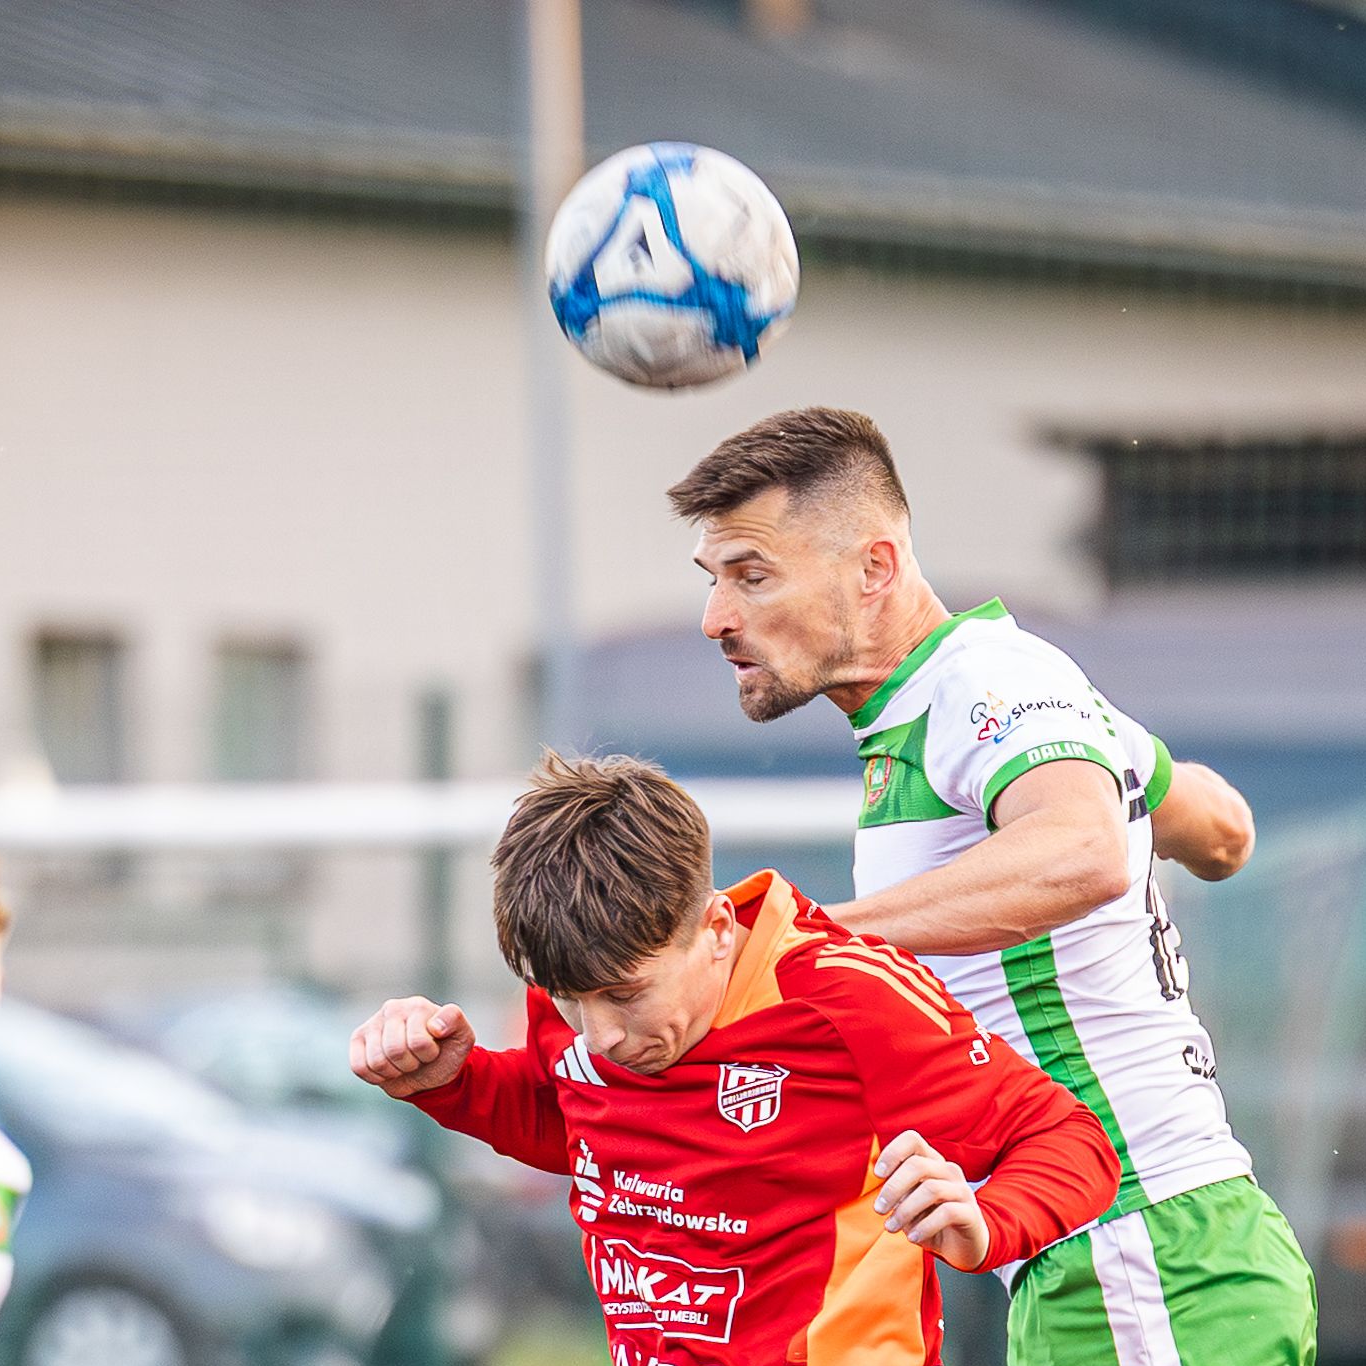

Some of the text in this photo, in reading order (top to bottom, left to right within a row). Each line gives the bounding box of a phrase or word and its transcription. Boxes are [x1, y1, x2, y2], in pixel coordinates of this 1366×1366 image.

[1026, 742, 1088, 764] DALIN
[613, 1170, 684, 1203] Kalwaria
[607, 1194, 748, 1235] Zebrzydowska
[600, 1257, 726, 1306] MAKAT
[670, 1310, 709, 1326] MEBLI
